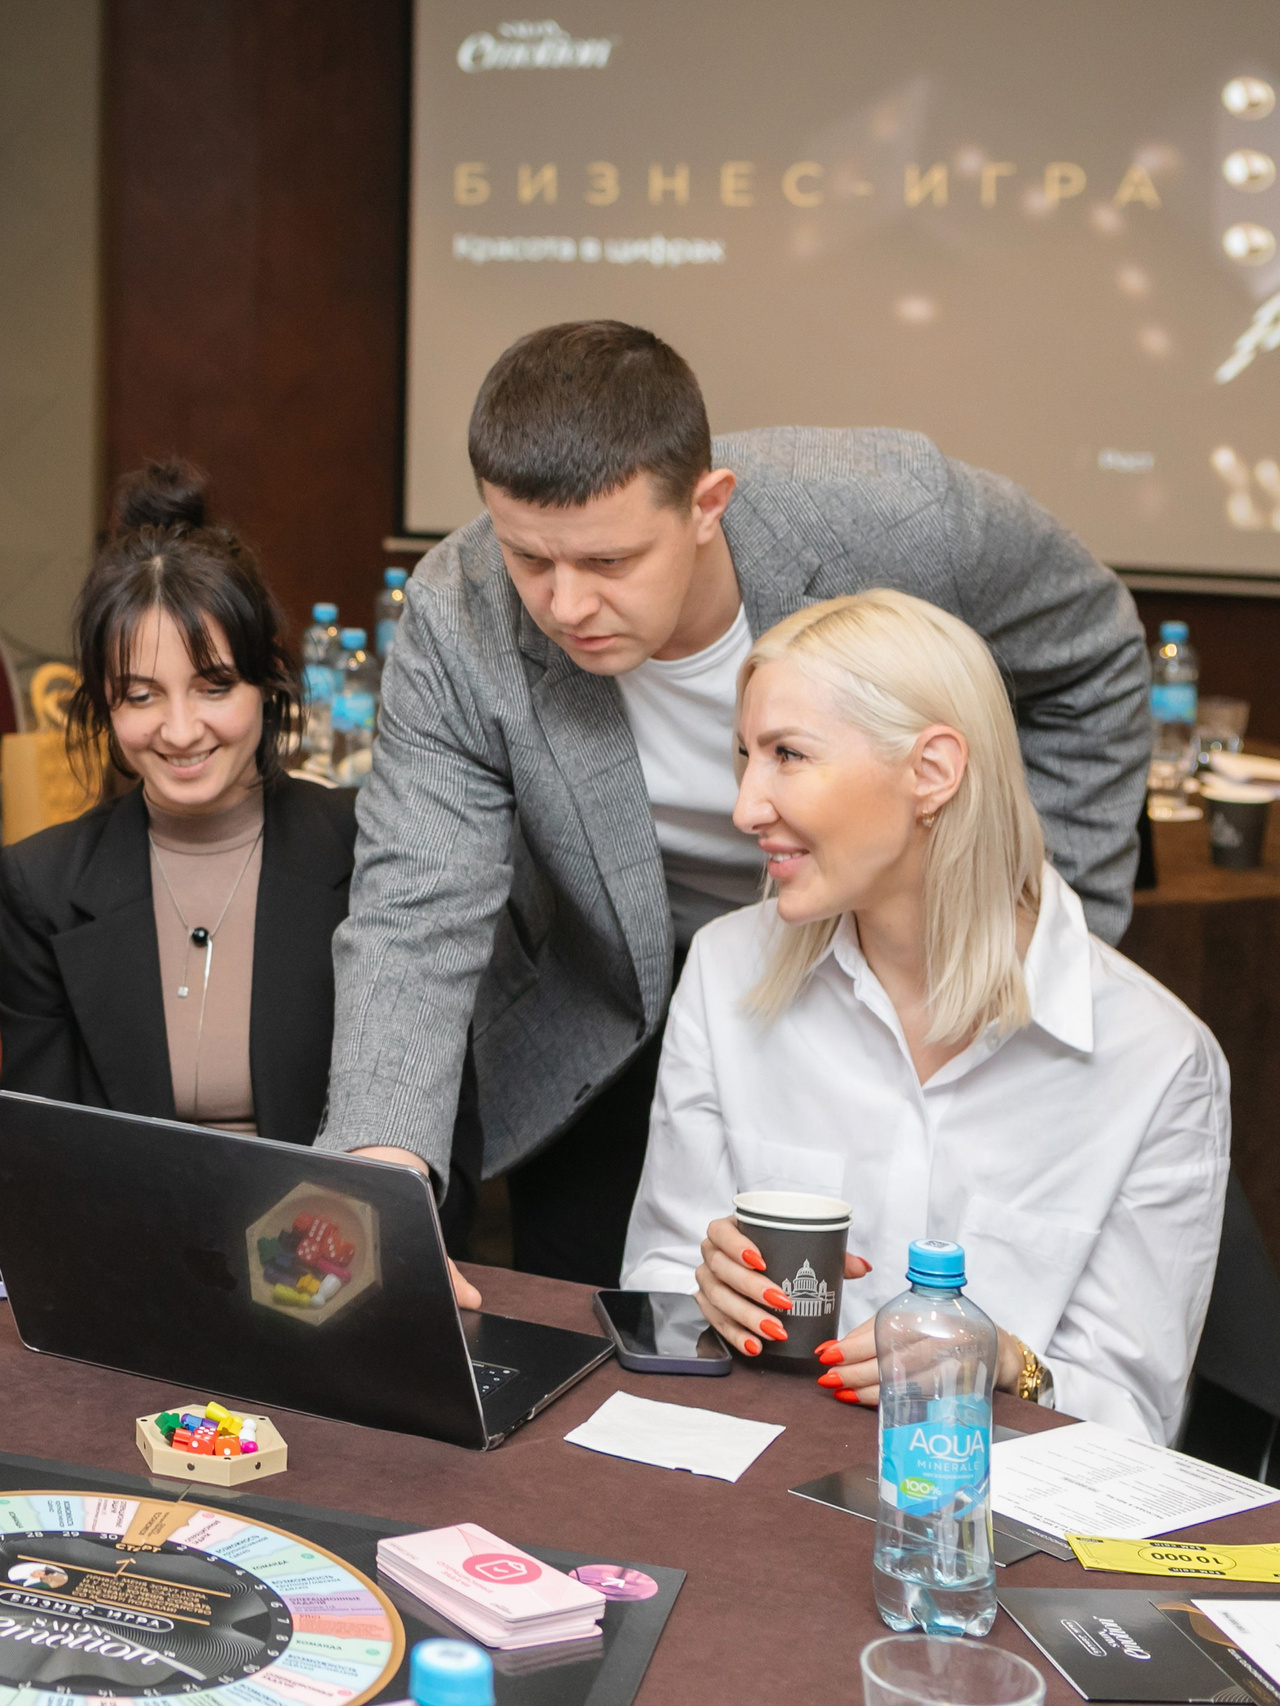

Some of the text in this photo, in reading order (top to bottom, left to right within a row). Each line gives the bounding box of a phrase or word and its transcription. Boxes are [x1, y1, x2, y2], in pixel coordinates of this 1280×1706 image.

[453, 161, 1163, 207] БИЗНЕС-ИГРА
[909, 1428, 985, 1462] AQUA
[917, 1460, 980, 1472] MINERALE
[905, 1479, 942, 1495] 100%
[1151, 1552, 1223, 1565] 10 000
